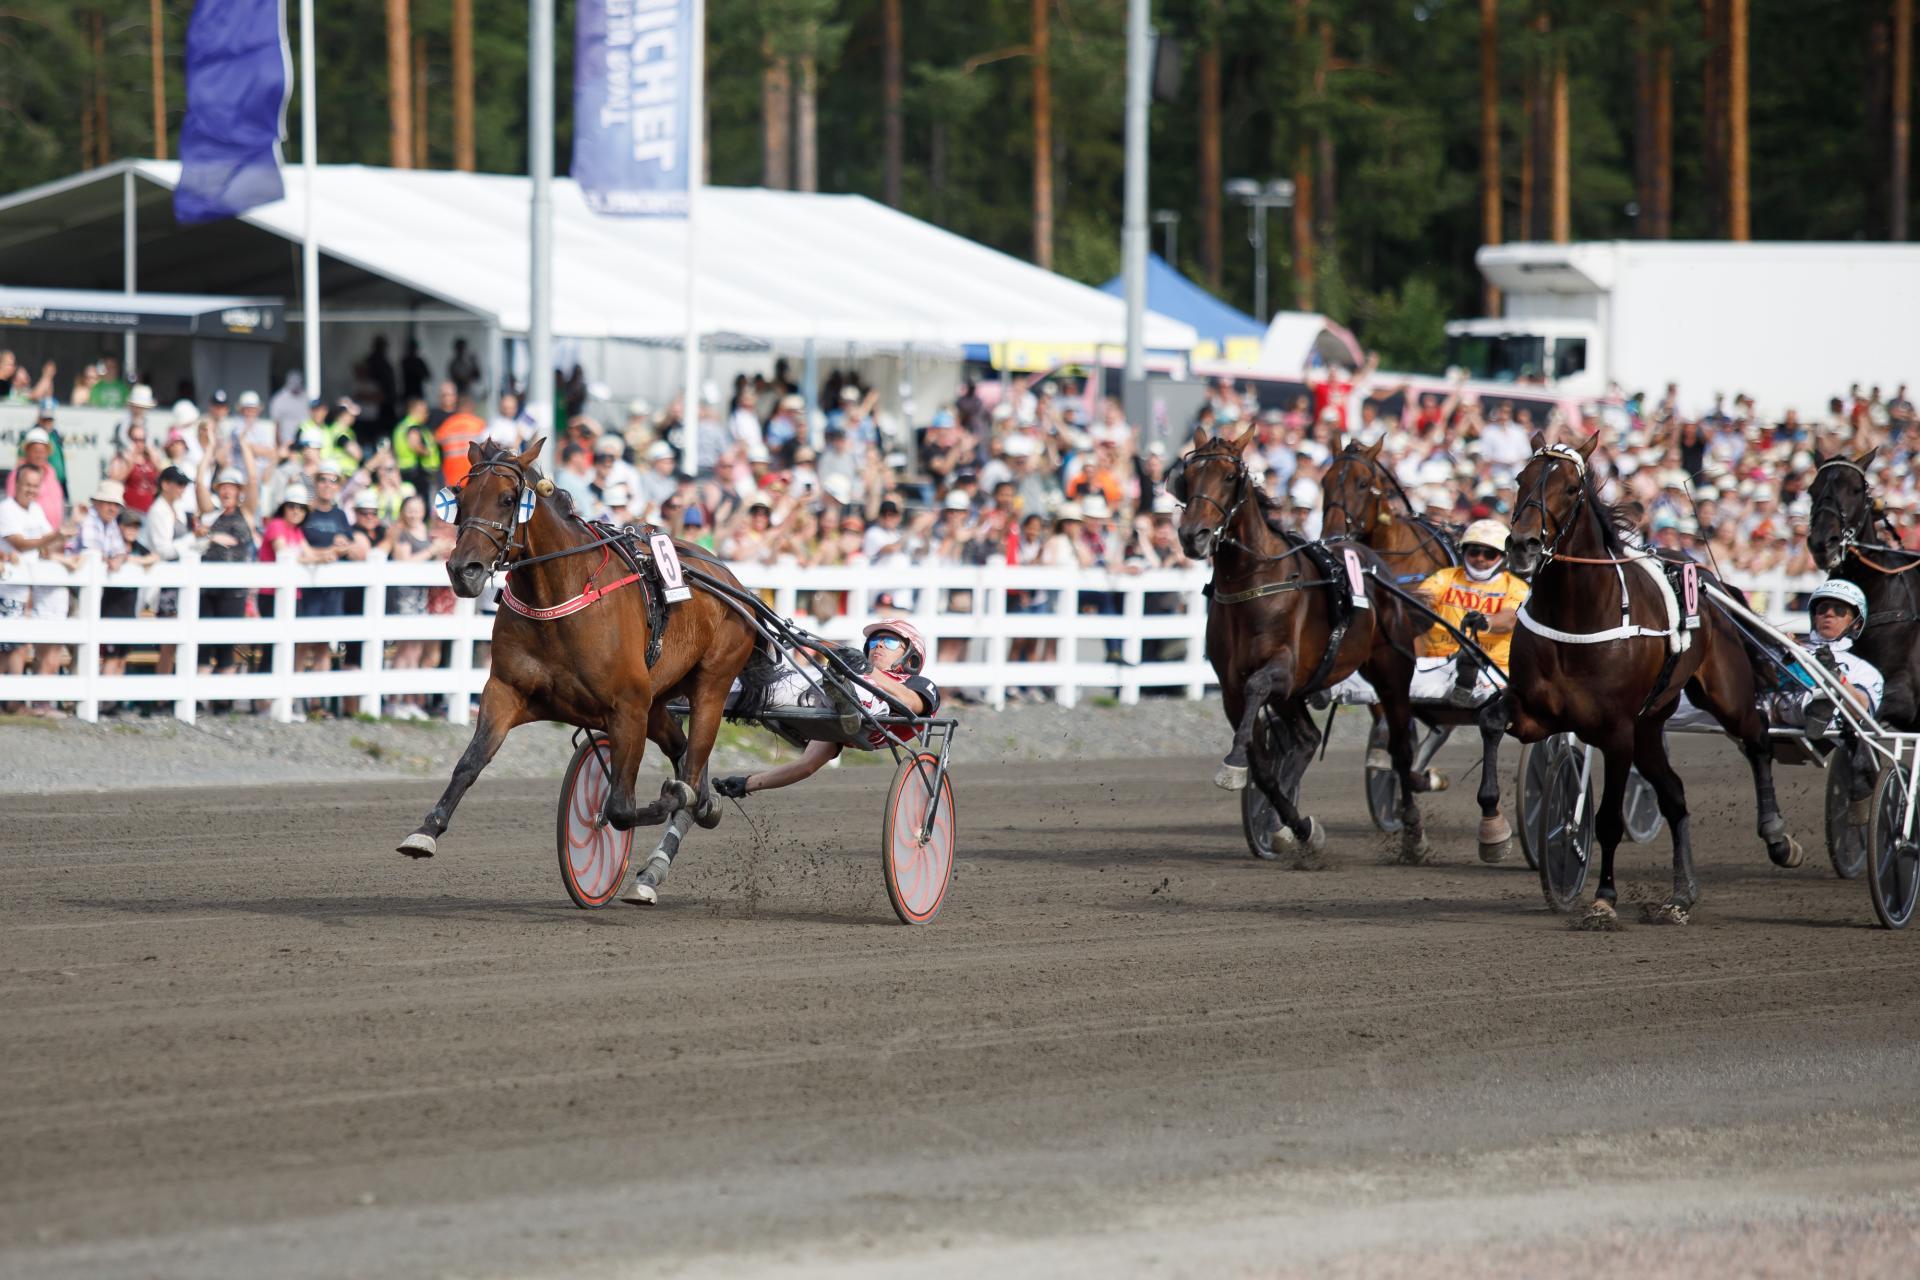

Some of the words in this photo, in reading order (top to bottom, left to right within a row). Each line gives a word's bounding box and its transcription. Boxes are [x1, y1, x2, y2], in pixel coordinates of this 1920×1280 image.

[658, 540, 676, 582] 5
[1687, 568, 1695, 609] 6
[1823, 582, 1850, 592] SVEA
